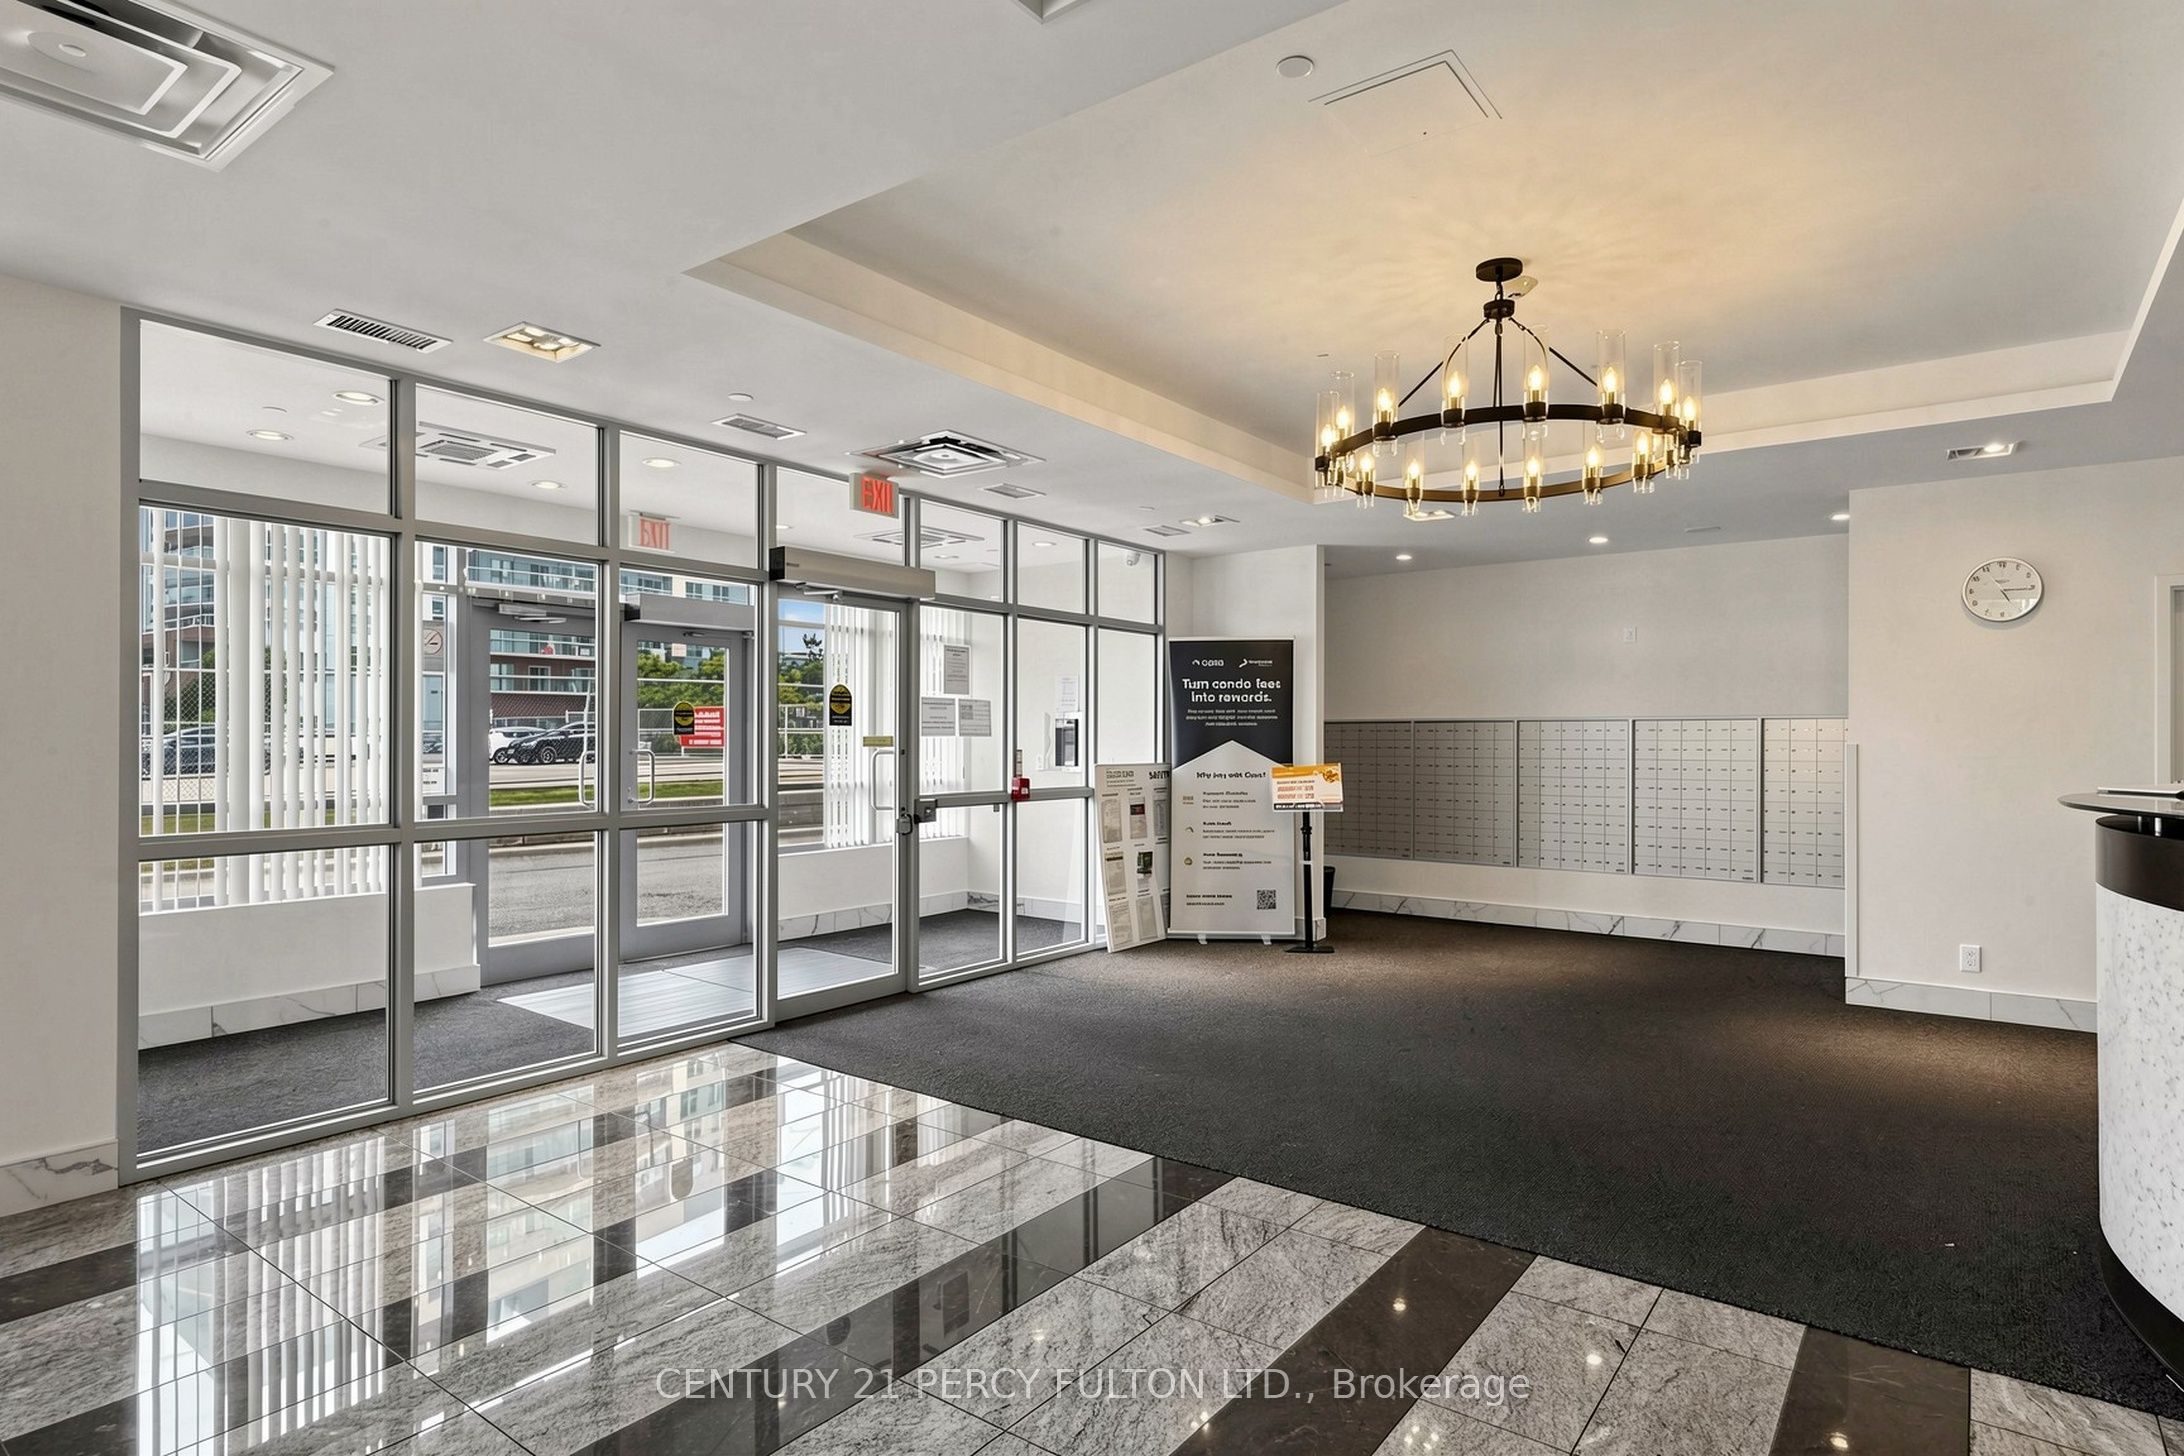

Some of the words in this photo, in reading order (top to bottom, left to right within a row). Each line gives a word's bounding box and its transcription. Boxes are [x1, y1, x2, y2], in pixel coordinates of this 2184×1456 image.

[861, 477, 893, 513] EXIT
[1182, 678, 1209, 689] Turn
[1211, 678, 1251, 689] condo
[1255, 678, 1281, 689] fees
[1218, 691, 1272, 702] rewards.
